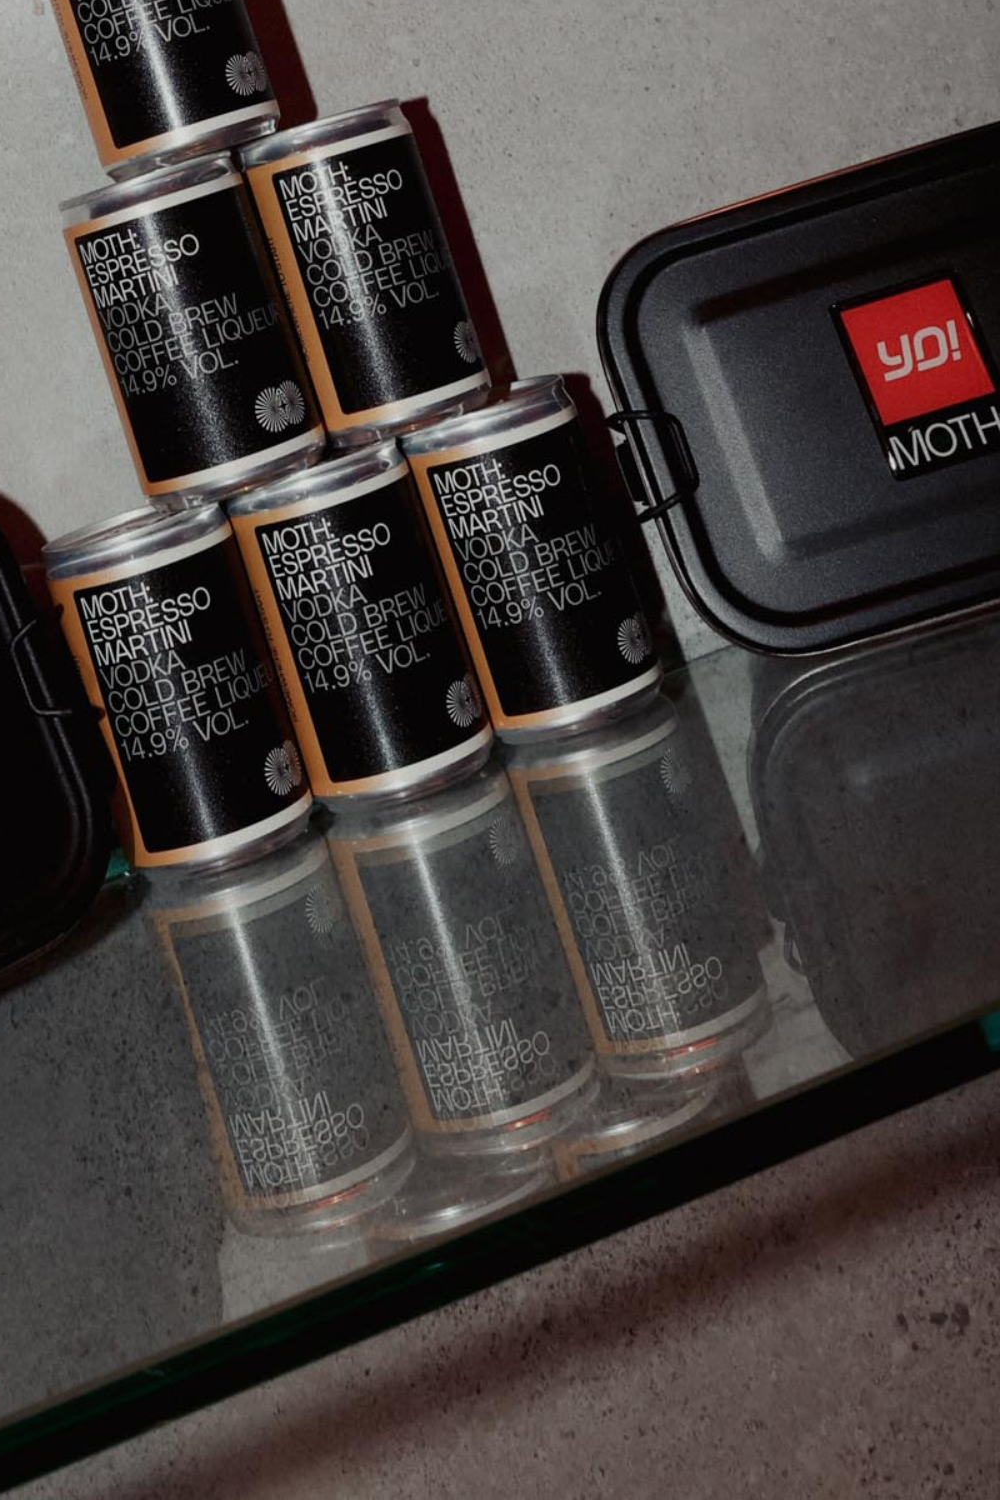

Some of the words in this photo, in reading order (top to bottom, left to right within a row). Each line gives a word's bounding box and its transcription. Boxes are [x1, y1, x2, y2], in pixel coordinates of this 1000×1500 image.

[154, 14, 210, 42] VOL.
[286, 169, 402, 222] ESPRESSO
[292, 197, 388, 243] MARTINI
[79, 228, 140, 266] MOTH:
[86, 234, 200, 286] ESPRESSO
[298, 224, 383, 264] VODKA
[306, 250, 373, 285] COLD
[378, 230, 434, 265] BREW
[93, 264, 179, 309] MARTINI
[313, 264, 406, 307] COFFEE
[319, 294, 387, 330] 14.9%
[390, 280, 440, 308] VOL.
[99, 292, 173, 330] VODKA
[107, 320, 163, 352] COLD
[168, 292, 238, 335] BREW
[115, 332, 198, 375] COFFEE
[122, 364, 177, 398] 14.9%
[180, 348, 239, 379] VOL.
[889, 406, 1000, 470] MOTH
[434, 458, 506, 495] MOTH:
[440, 464, 561, 517] ESPRESSO
[262, 518, 335, 555] MOTH:
[448, 494, 544, 539] MARTINI
[268, 522, 390, 578] ESPRESSO
[455, 524, 540, 562] VODKA
[464, 551, 529, 585] COLD
[534, 523, 597, 566] BREW
[80, 582, 154, 620] MOTH:
[276, 554, 374, 601] MARTINI
[470, 564, 565, 607] COFFEE
[87, 586, 210, 643] ESPRESSO
[282, 584, 368, 624] VODKA
[290, 612, 357, 646] COLD
[363, 583, 426, 628] BREW
[477, 596, 544, 630] 14.9%
[547, 579, 602, 611] VOL.
[94, 619, 192, 666] MARTINI
[298, 625, 393, 670] COFFEE
[396, 599, 448, 642] LIQUE
[100, 650, 186, 690] VODKA
[108, 678, 175, 714] COLD
[181, 648, 246, 695] BREW
[304, 659, 372, 693] 14.9%
[375, 642, 431, 674] VOL.
[115, 691, 211, 738] COFFEE
[122, 724, 189, 762] 14.9%
[192, 708, 249, 742] VOL.
